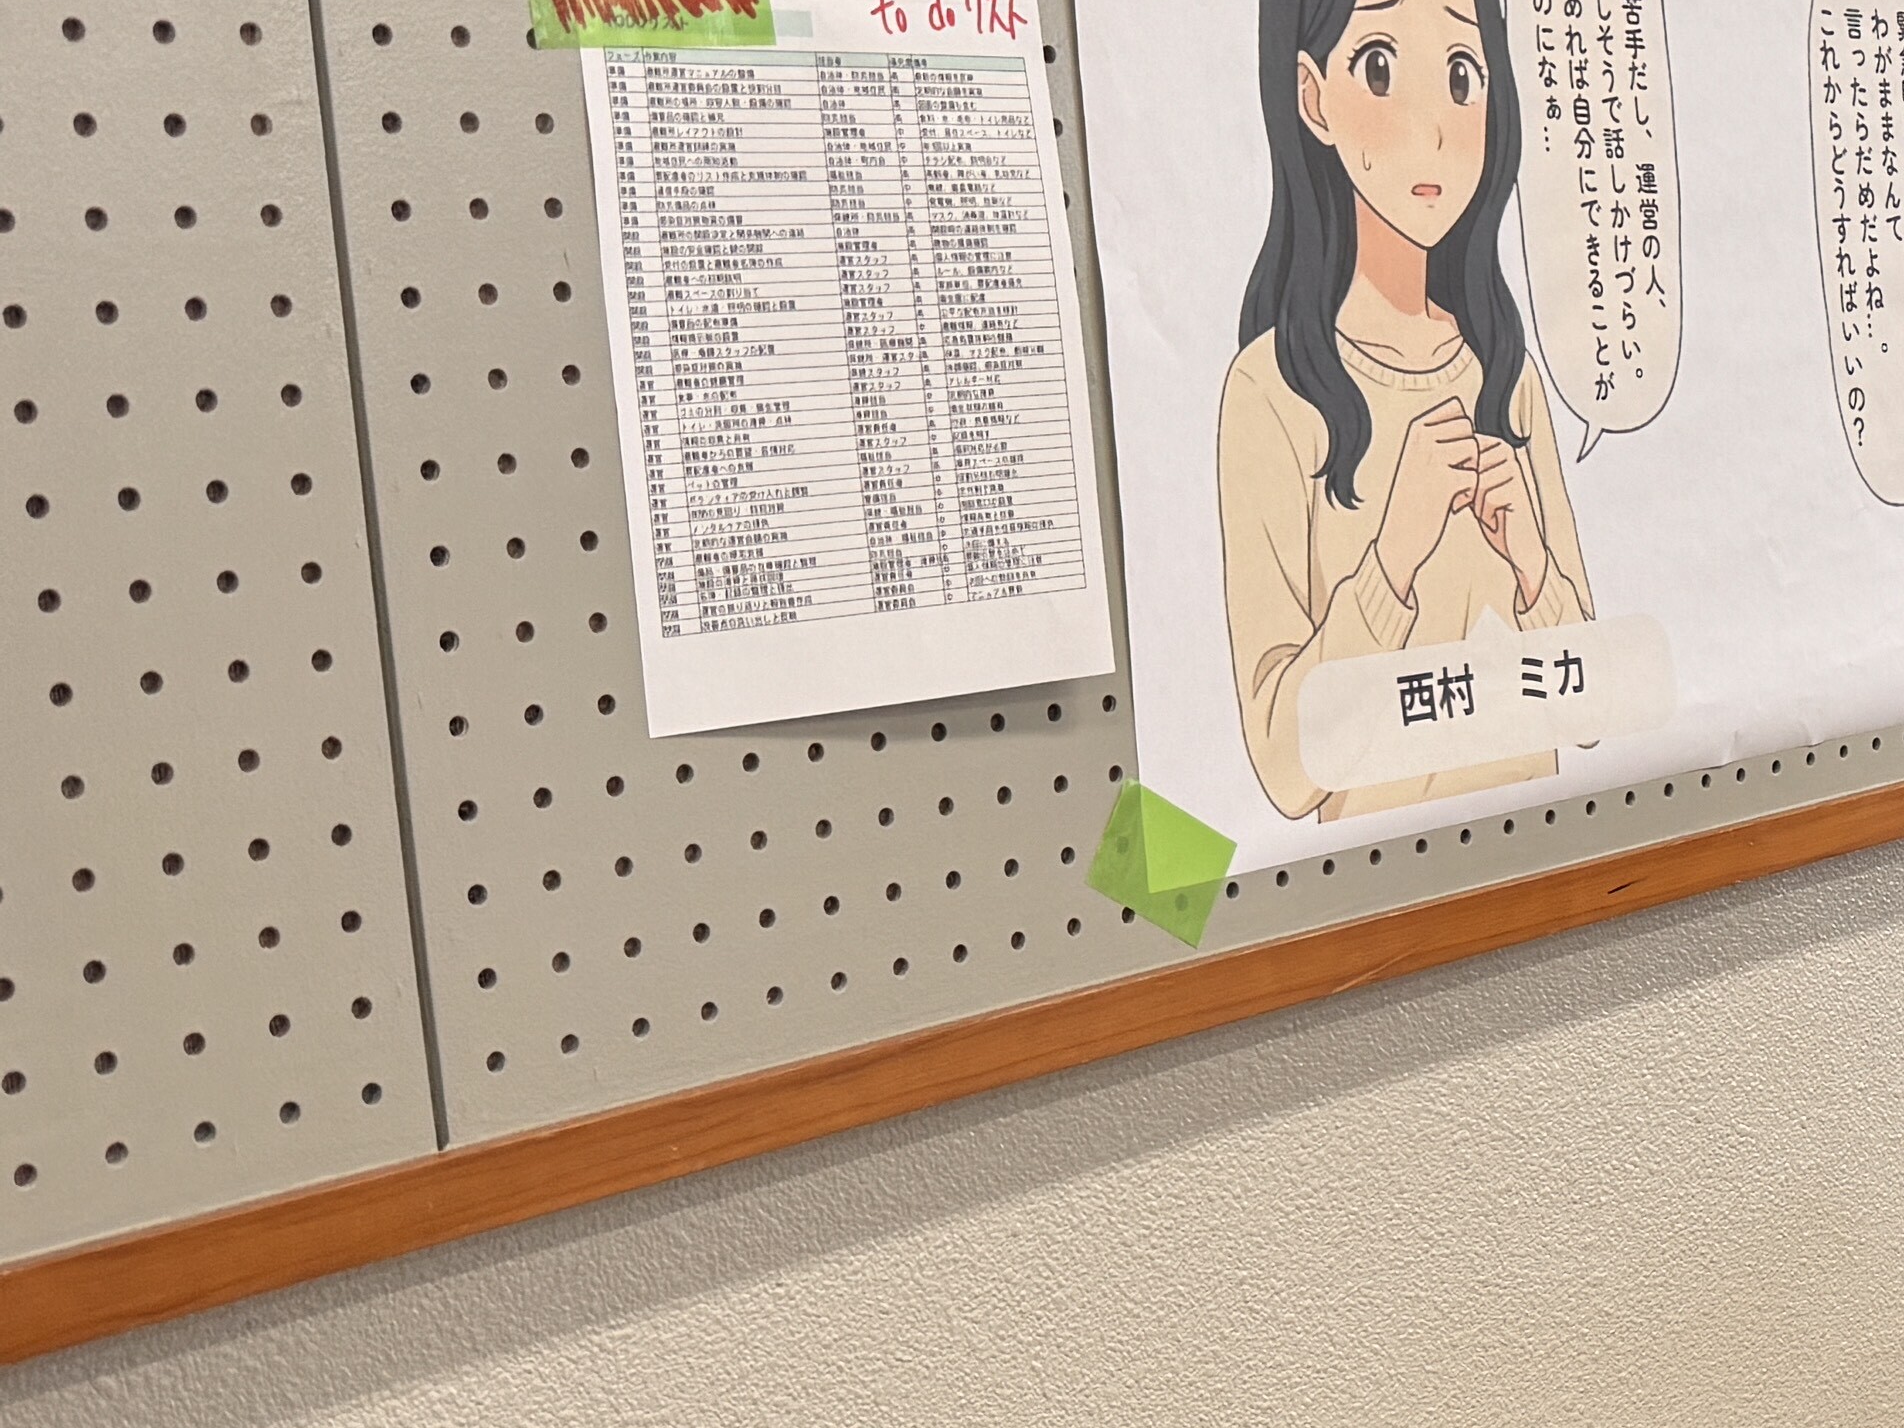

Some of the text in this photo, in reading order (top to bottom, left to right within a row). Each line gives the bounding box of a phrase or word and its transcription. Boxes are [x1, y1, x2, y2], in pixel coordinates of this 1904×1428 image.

[1819, 10, 1867, 448] これからどうすればいいの？
[1870, 10, 1902, 242] わがままなんて
[1397, 650, 1585, 725] 西村 ミカ
